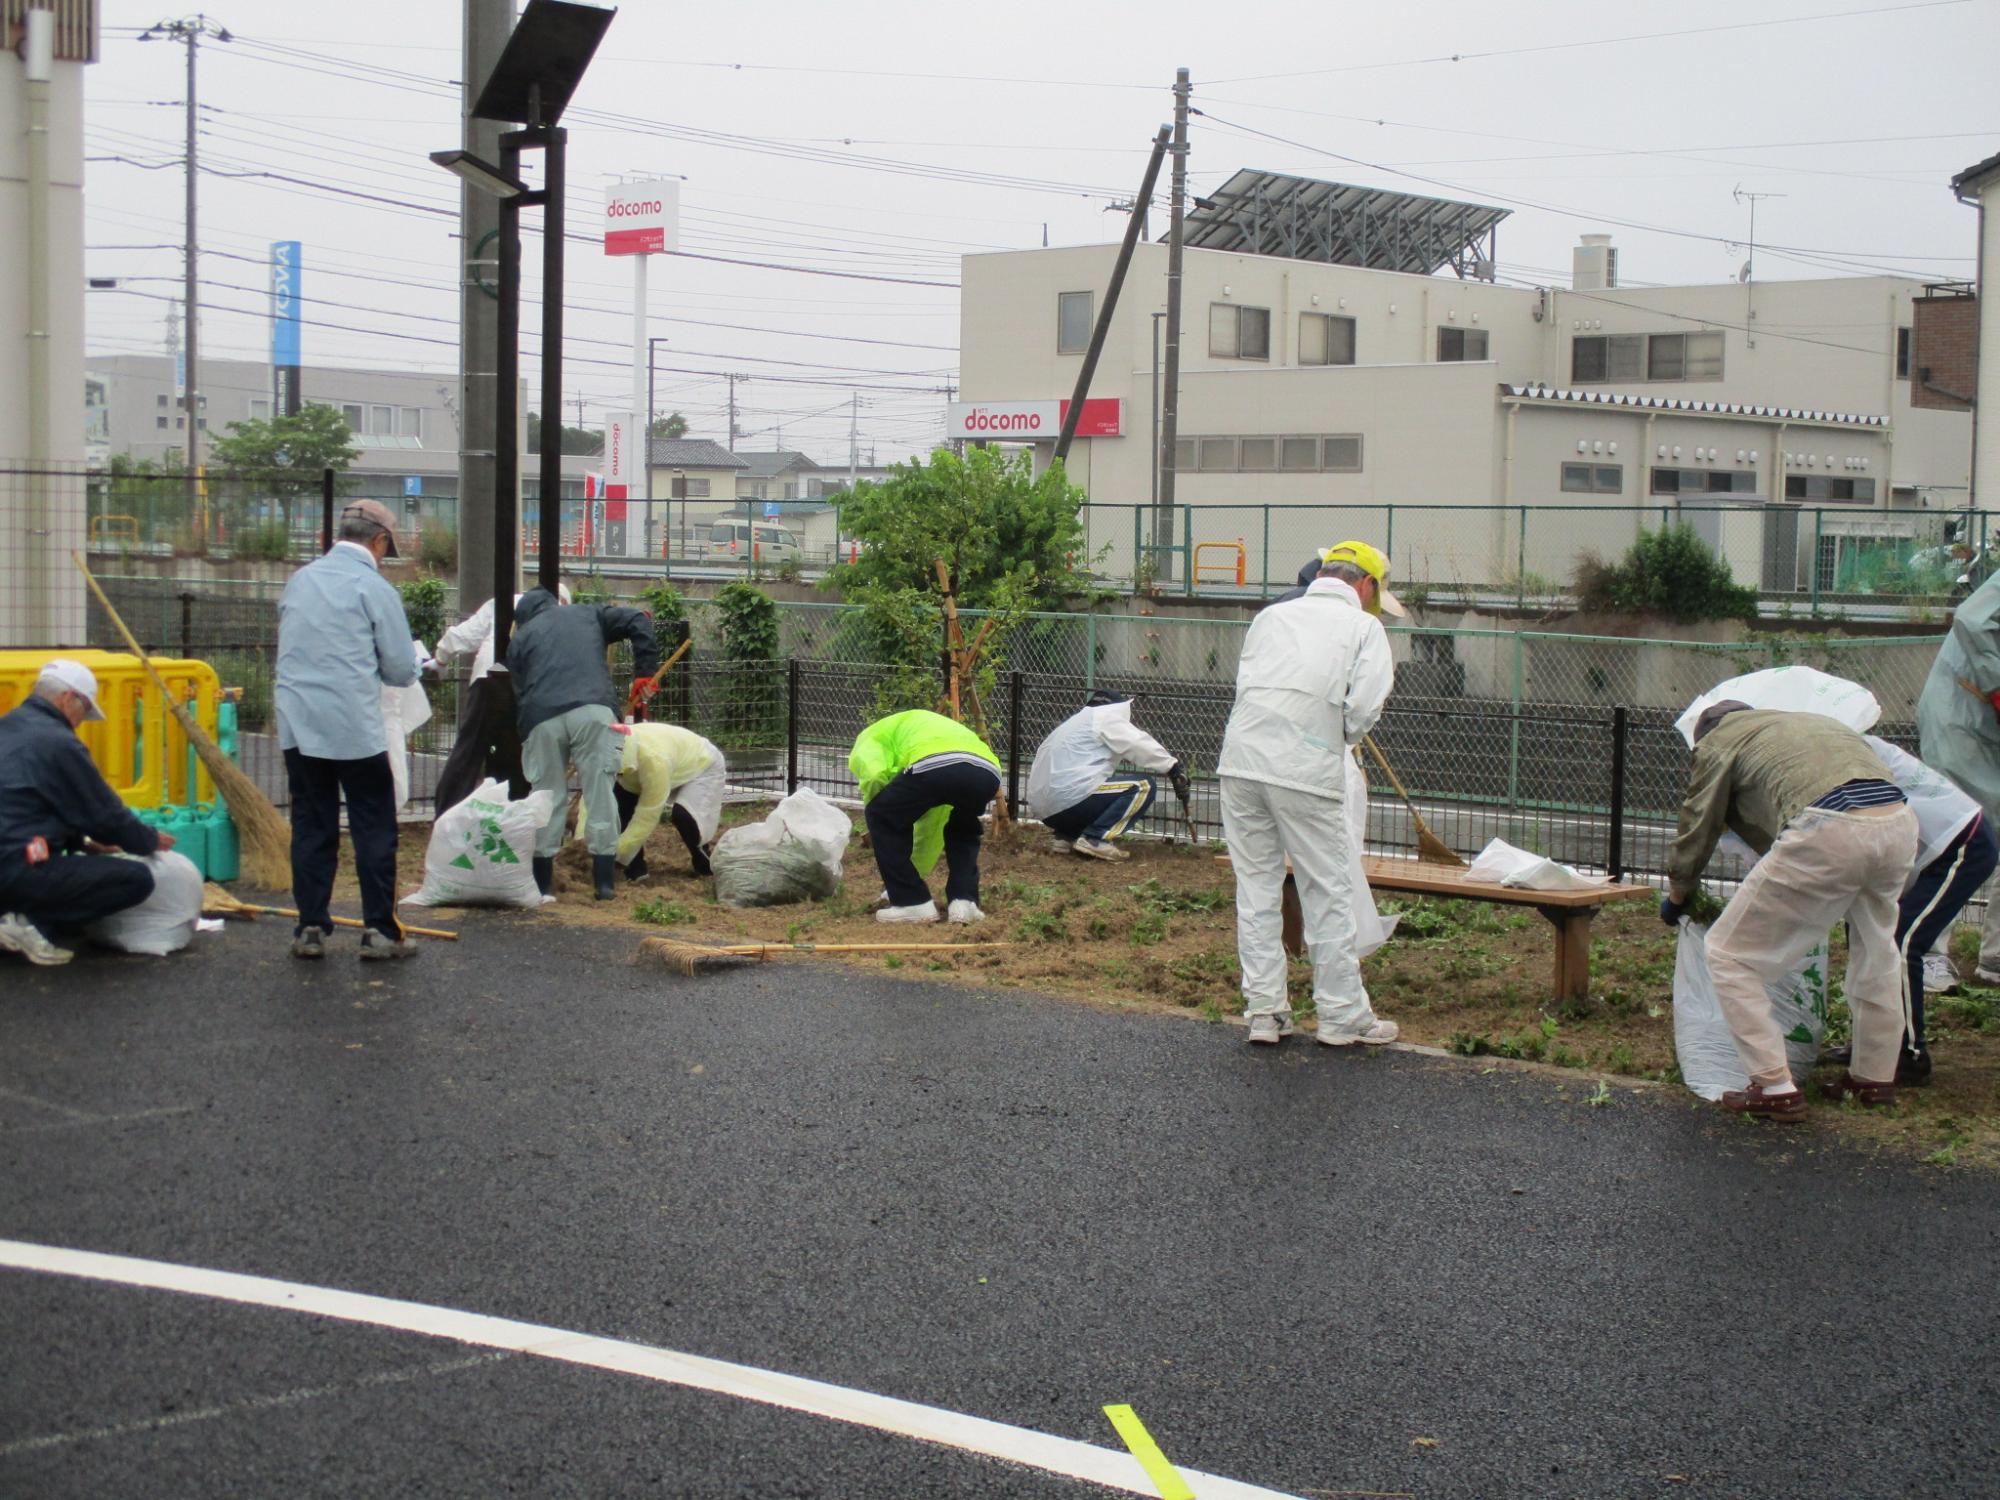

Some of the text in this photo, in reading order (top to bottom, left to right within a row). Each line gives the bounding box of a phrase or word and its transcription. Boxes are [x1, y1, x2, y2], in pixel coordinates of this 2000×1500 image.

[607, 200, 662, 217] docomo
[965, 409, 1041, 430] docomo
[612, 423, 620, 476] docomo
[612, 526, 619, 537] P
